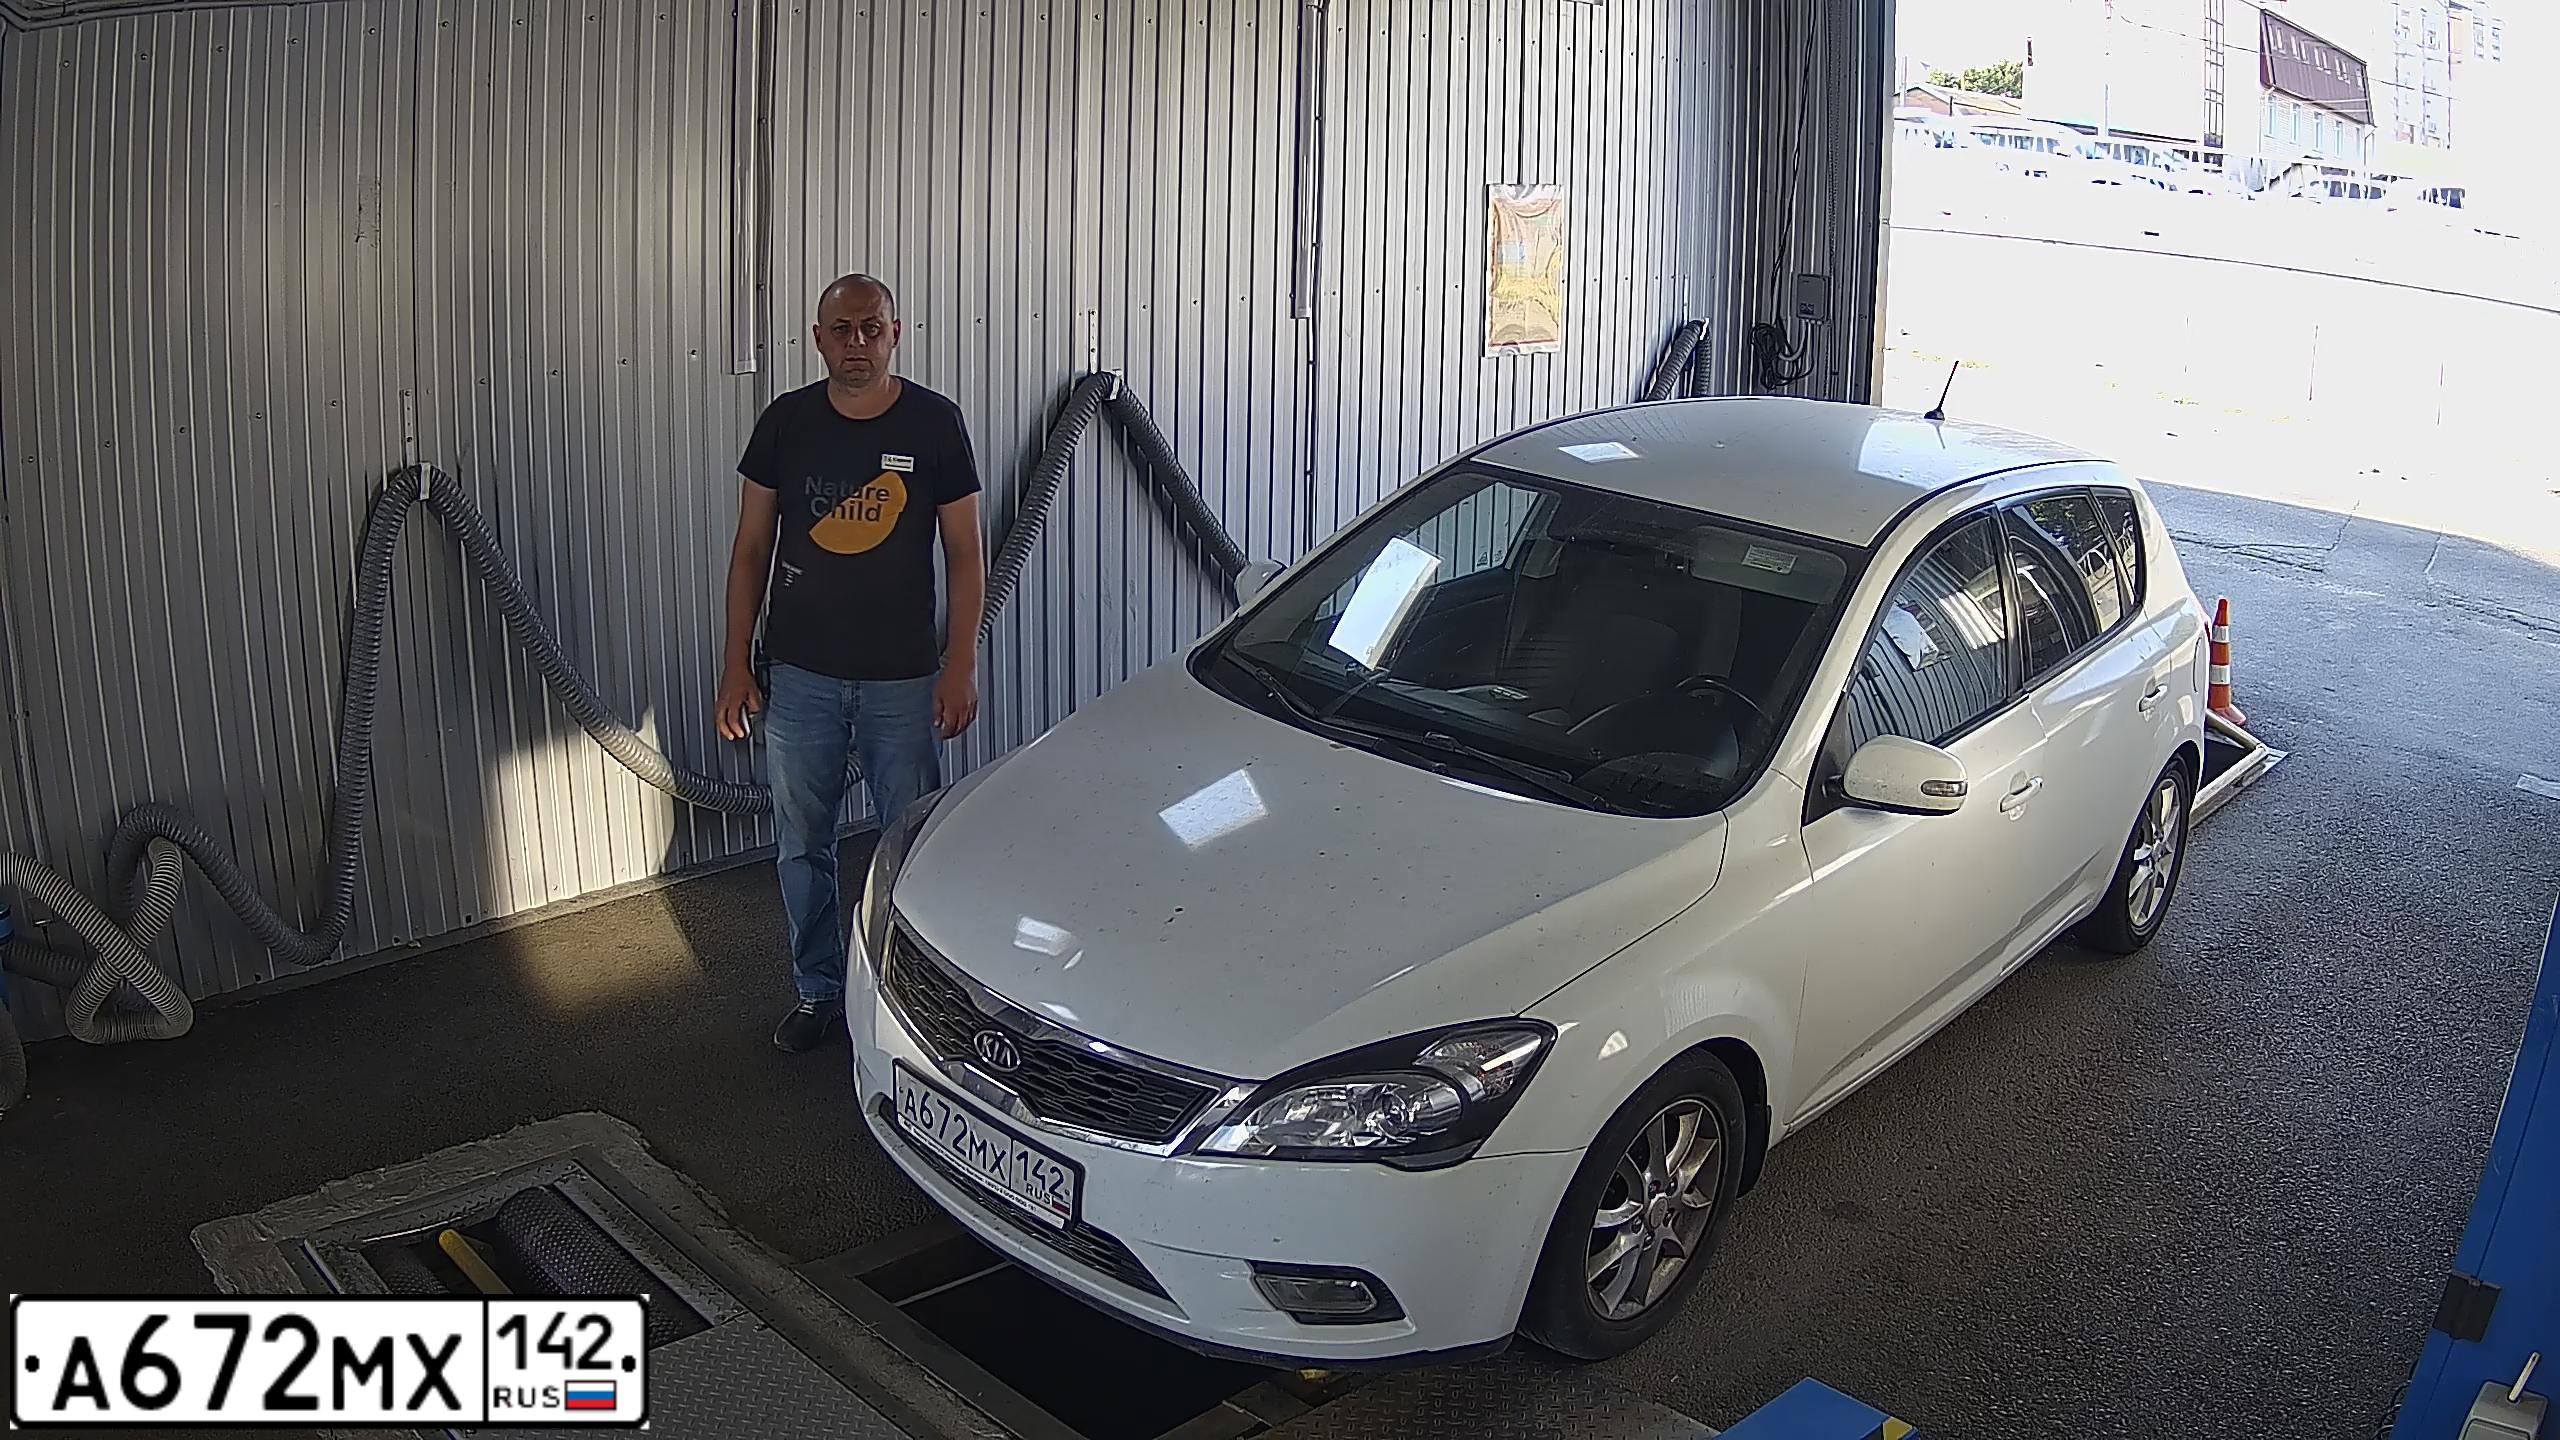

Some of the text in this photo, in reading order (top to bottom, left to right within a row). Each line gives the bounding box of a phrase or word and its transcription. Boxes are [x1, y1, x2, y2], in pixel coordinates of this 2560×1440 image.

[804, 476, 890, 502] Nature
[810, 497, 881, 522] Child
[1015, 1150, 1066, 1201] 142
[1025, 1184, 1052, 1204] RUS
